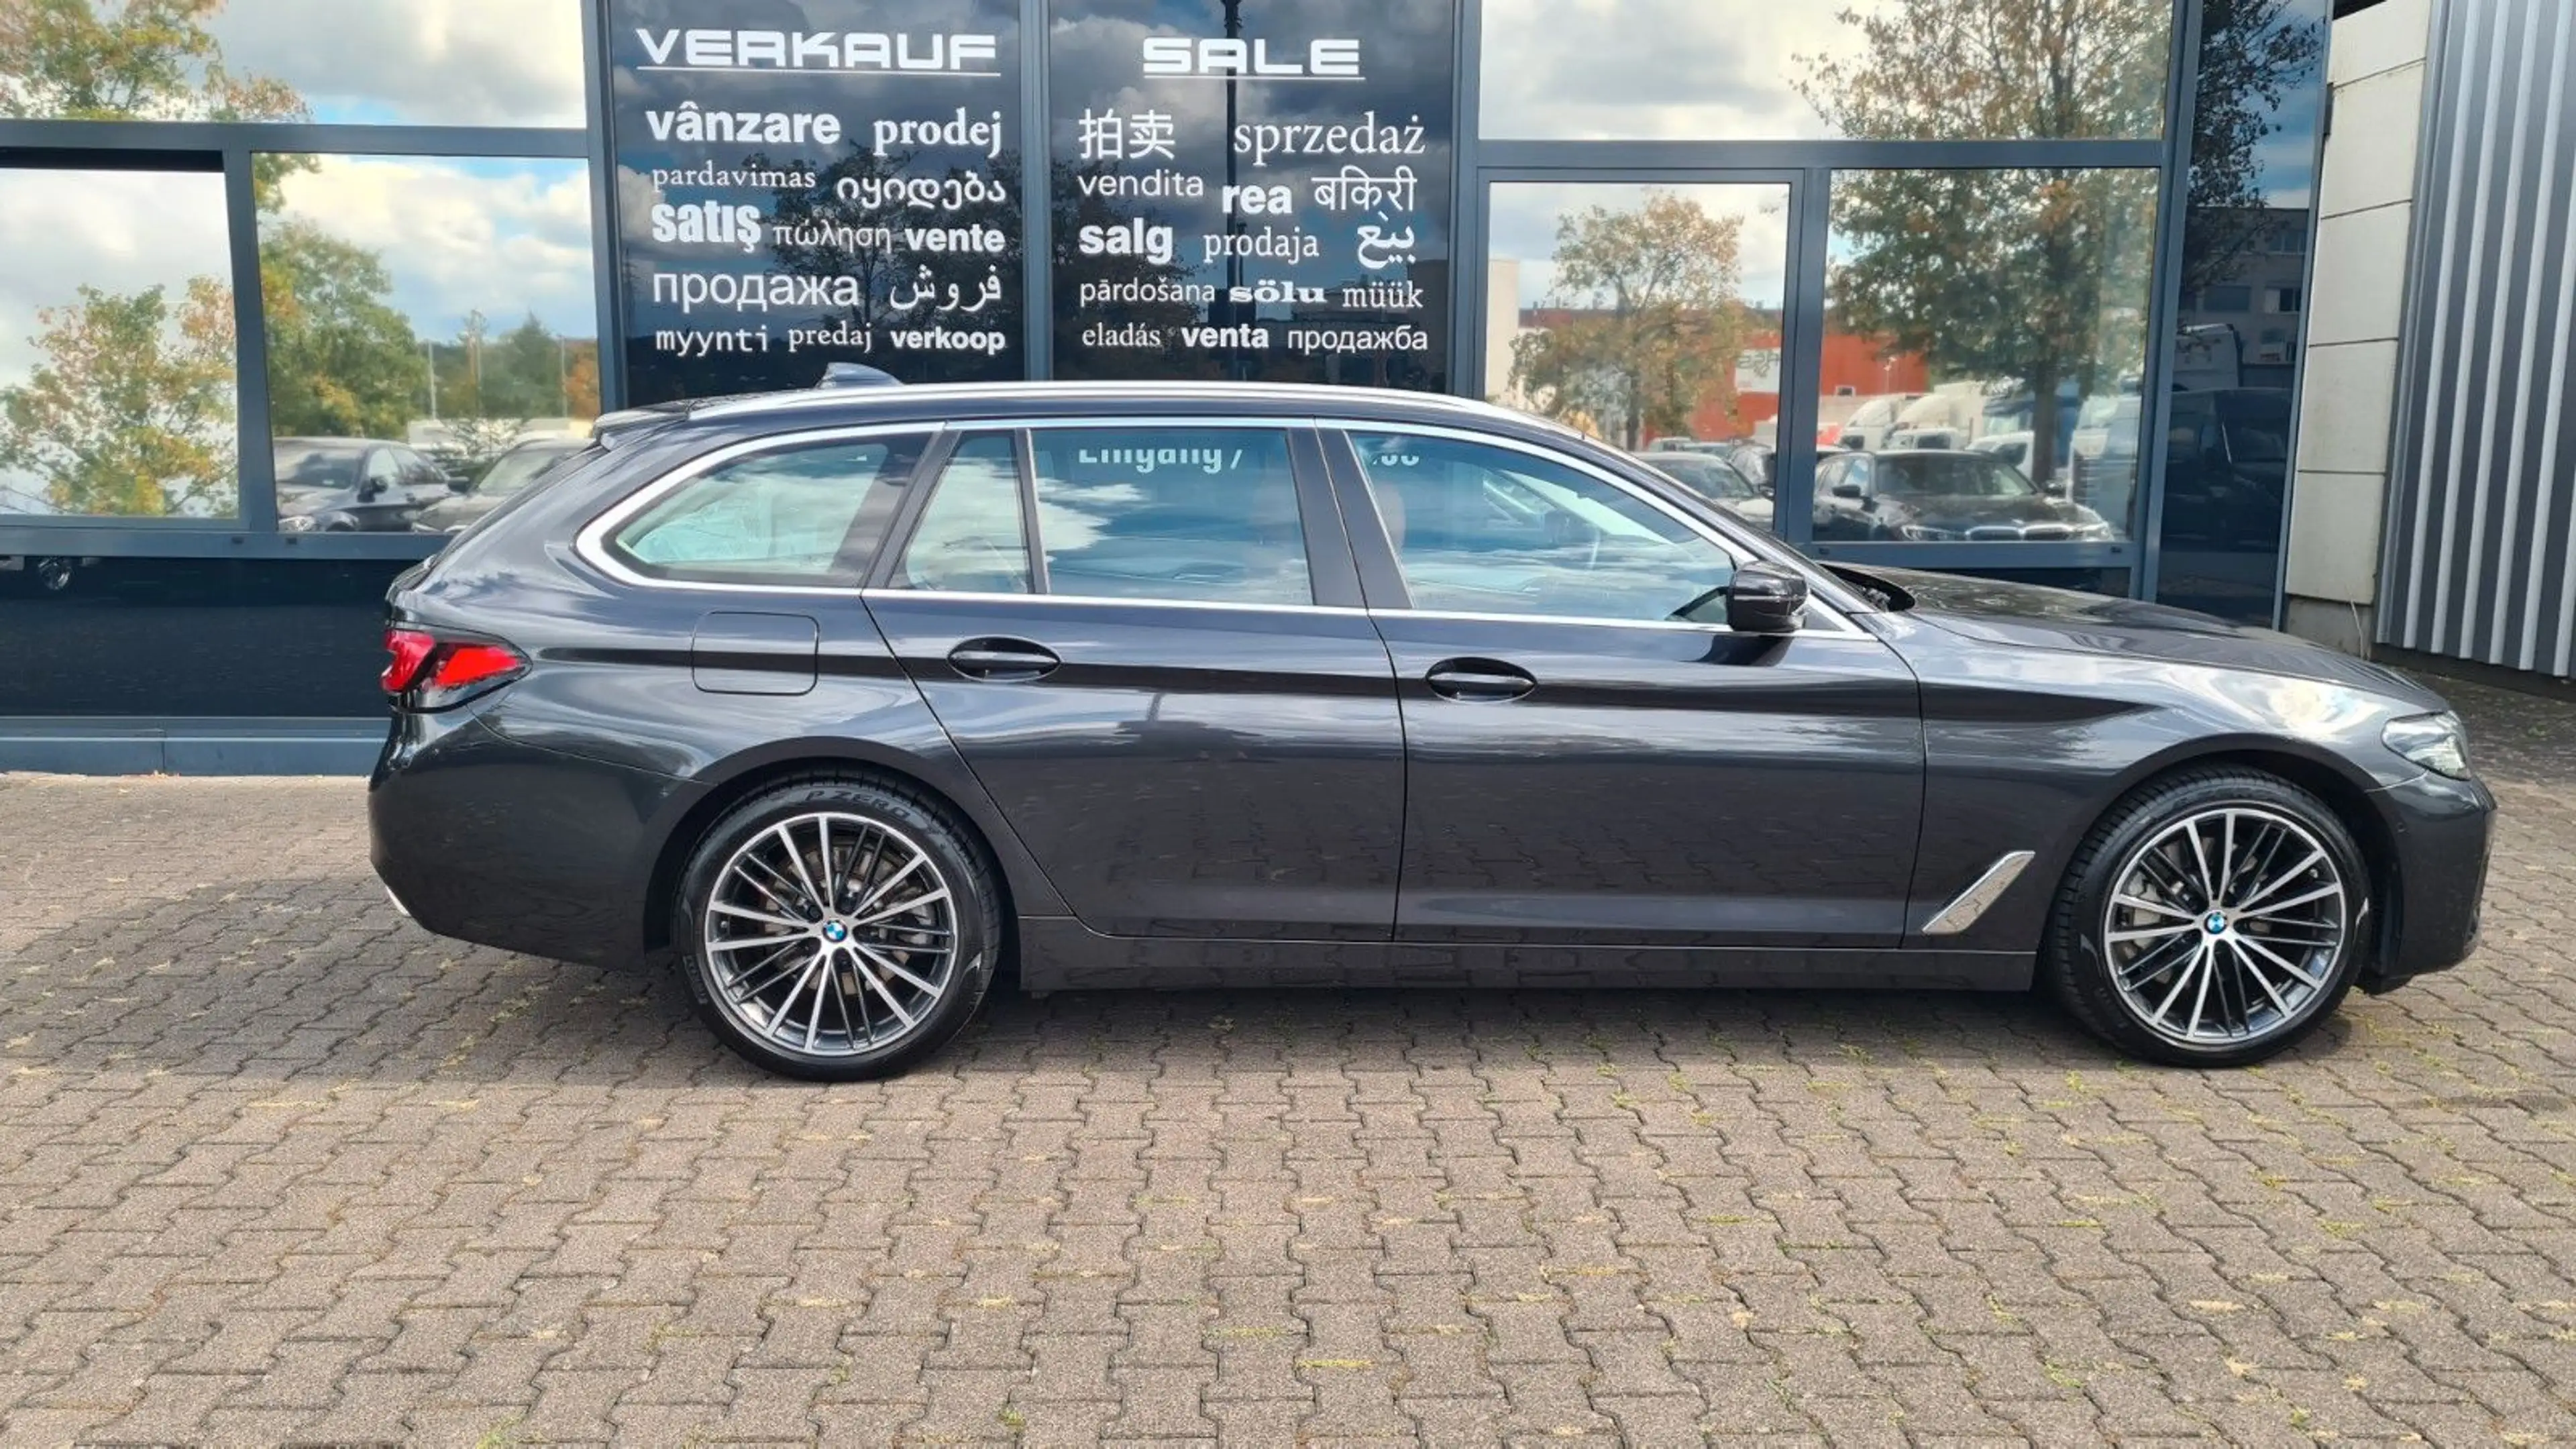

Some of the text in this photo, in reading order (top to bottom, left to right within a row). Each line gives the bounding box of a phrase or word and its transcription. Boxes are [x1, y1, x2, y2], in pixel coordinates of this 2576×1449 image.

[636, 29, 996, 69] VERKAUF
[1143, 38, 1360, 75] SALE
[646, 101, 841, 144] vânzare
[873, 107, 1002, 158] prodej
[1079, 108, 1176, 160] 拍卖
[1234, 111, 1426, 167] sprzedaż
[651, 160, 816, 191] pardavimas
[837, 170, 1006, 211] იყიდება
[1077, 168, 1204, 197] vendita
[1222, 184, 1293, 215] rea
[651, 200, 761, 253] satış
[773, 221, 892, 254] πώληση
[904, 223, 1006, 253] vente
[1079, 217, 1173, 265] salg
[1203, 226, 1320, 265] prodaja
[653, 273, 860, 313] продажа
[890, 264, 1002, 312] فروش
[1080, 277, 1216, 308] pārdošana
[1229, 279, 1328, 304] sölu
[1342, 280, 1424, 309] müük
[655, 325, 767, 357] myynti
[788, 321, 871, 354] predaj
[890, 326, 1006, 356] verkoop
[1081, 322, 1162, 347] eladás
[1181, 323, 1270, 349] venta
[1287, 325, 1428, 354] продажба
